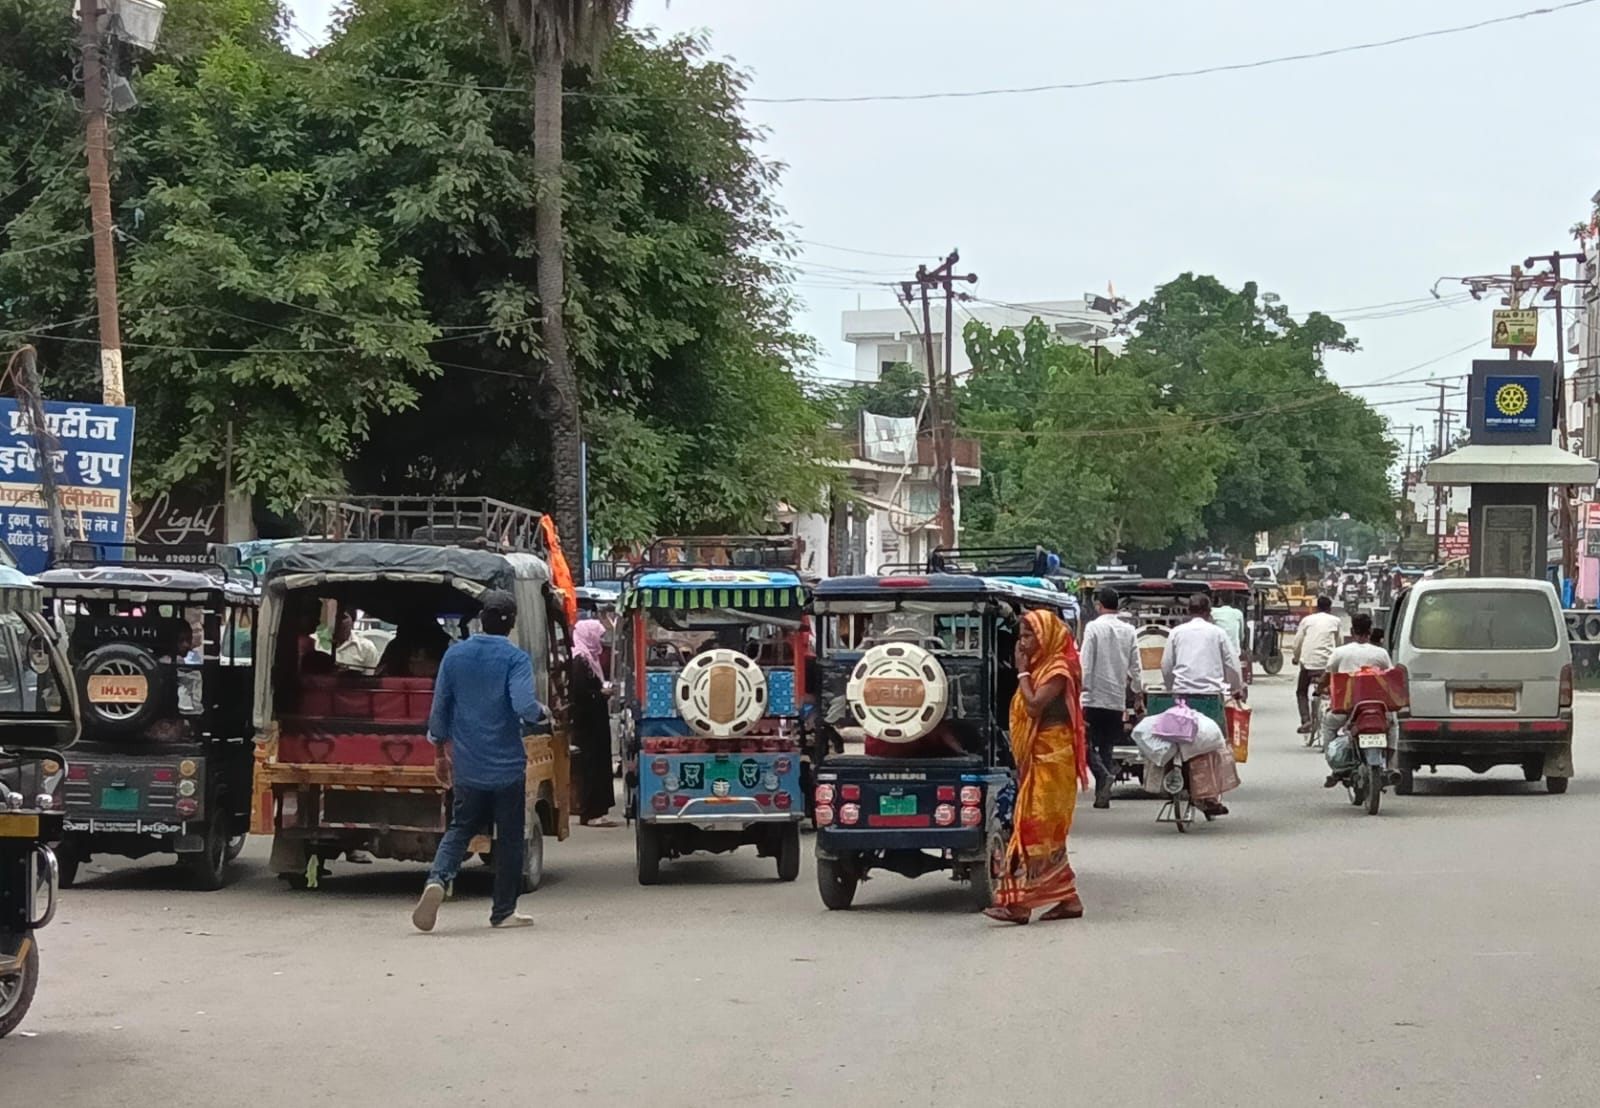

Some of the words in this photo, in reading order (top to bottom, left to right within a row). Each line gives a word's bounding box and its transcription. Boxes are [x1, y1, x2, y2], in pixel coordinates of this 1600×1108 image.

[76, 450, 124, 485] ग्रुप
[134, 492, 225, 545] Light
[100, 686, 138, 696] SATHI
